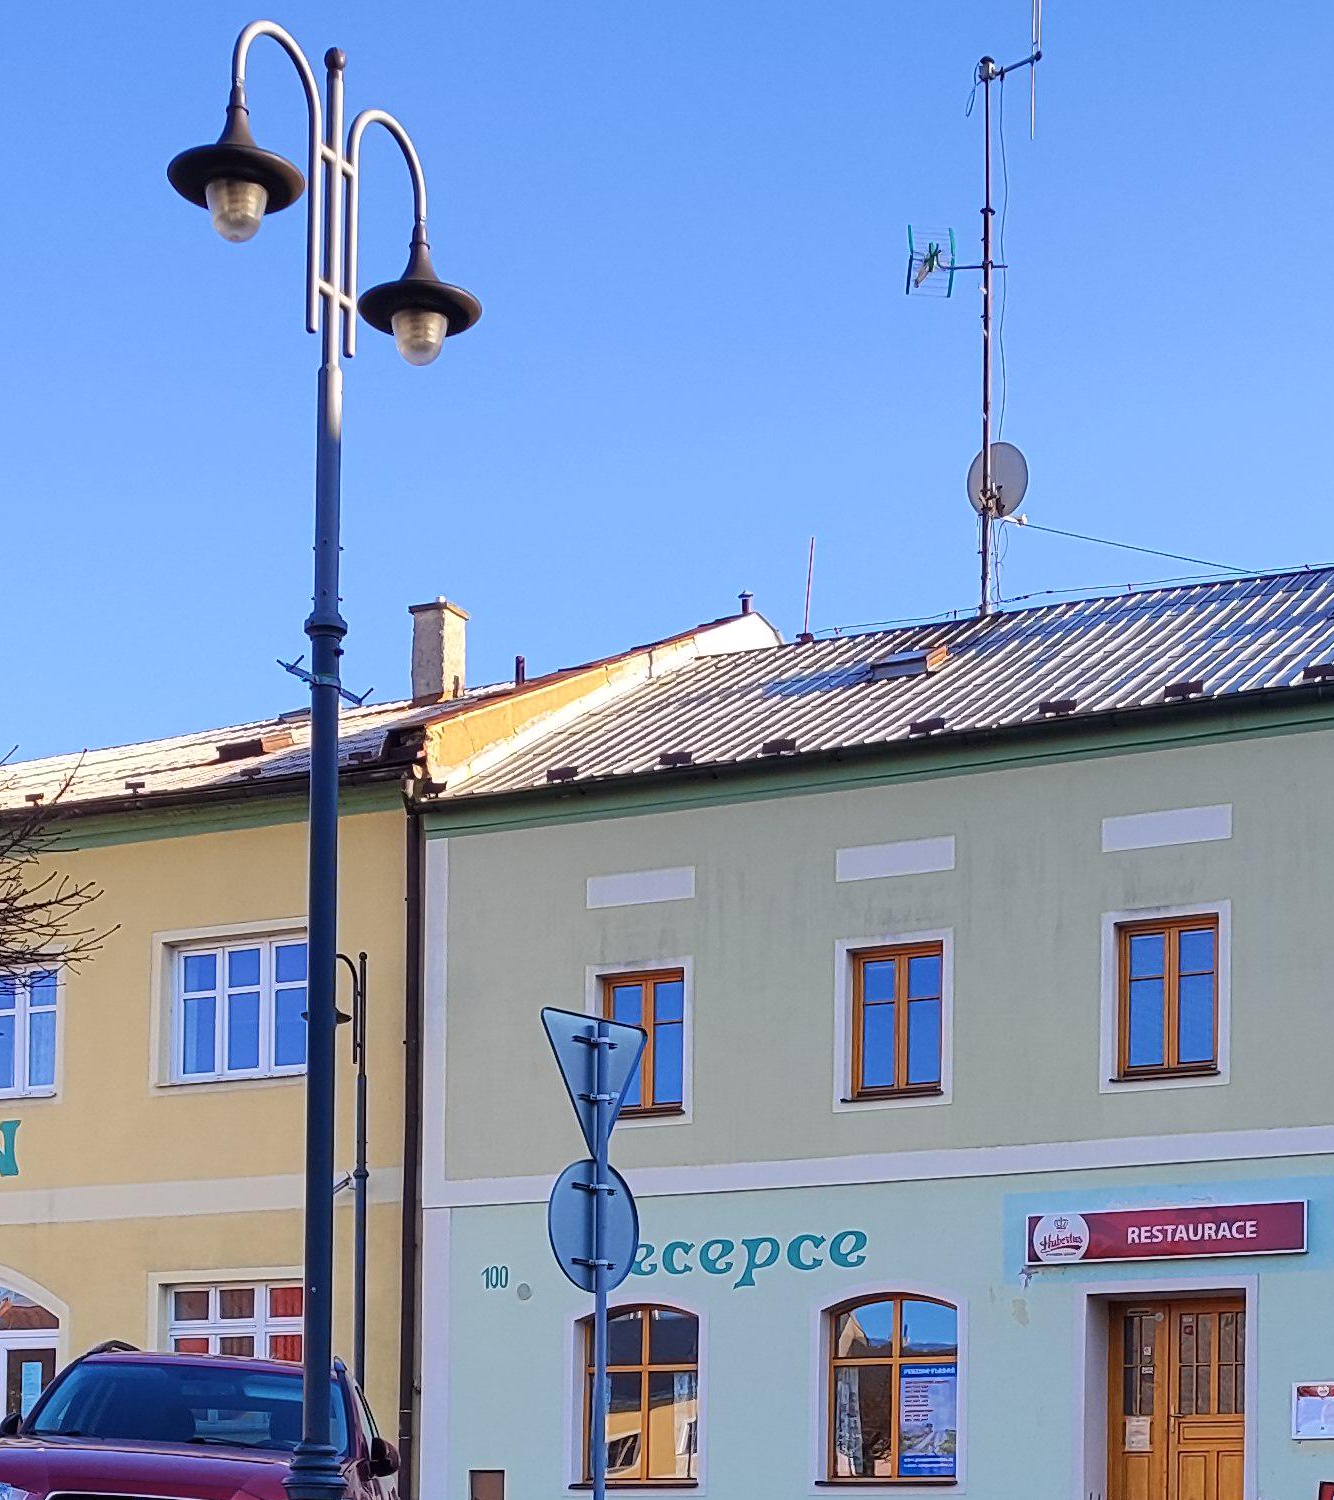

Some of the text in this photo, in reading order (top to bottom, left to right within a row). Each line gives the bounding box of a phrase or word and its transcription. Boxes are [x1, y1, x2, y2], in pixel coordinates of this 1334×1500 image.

[1127, 1220, 1258, 1244] RESTAURACE
[631, 1230, 867, 1289] ecepce
[481, 1265, 509, 1290] 100
